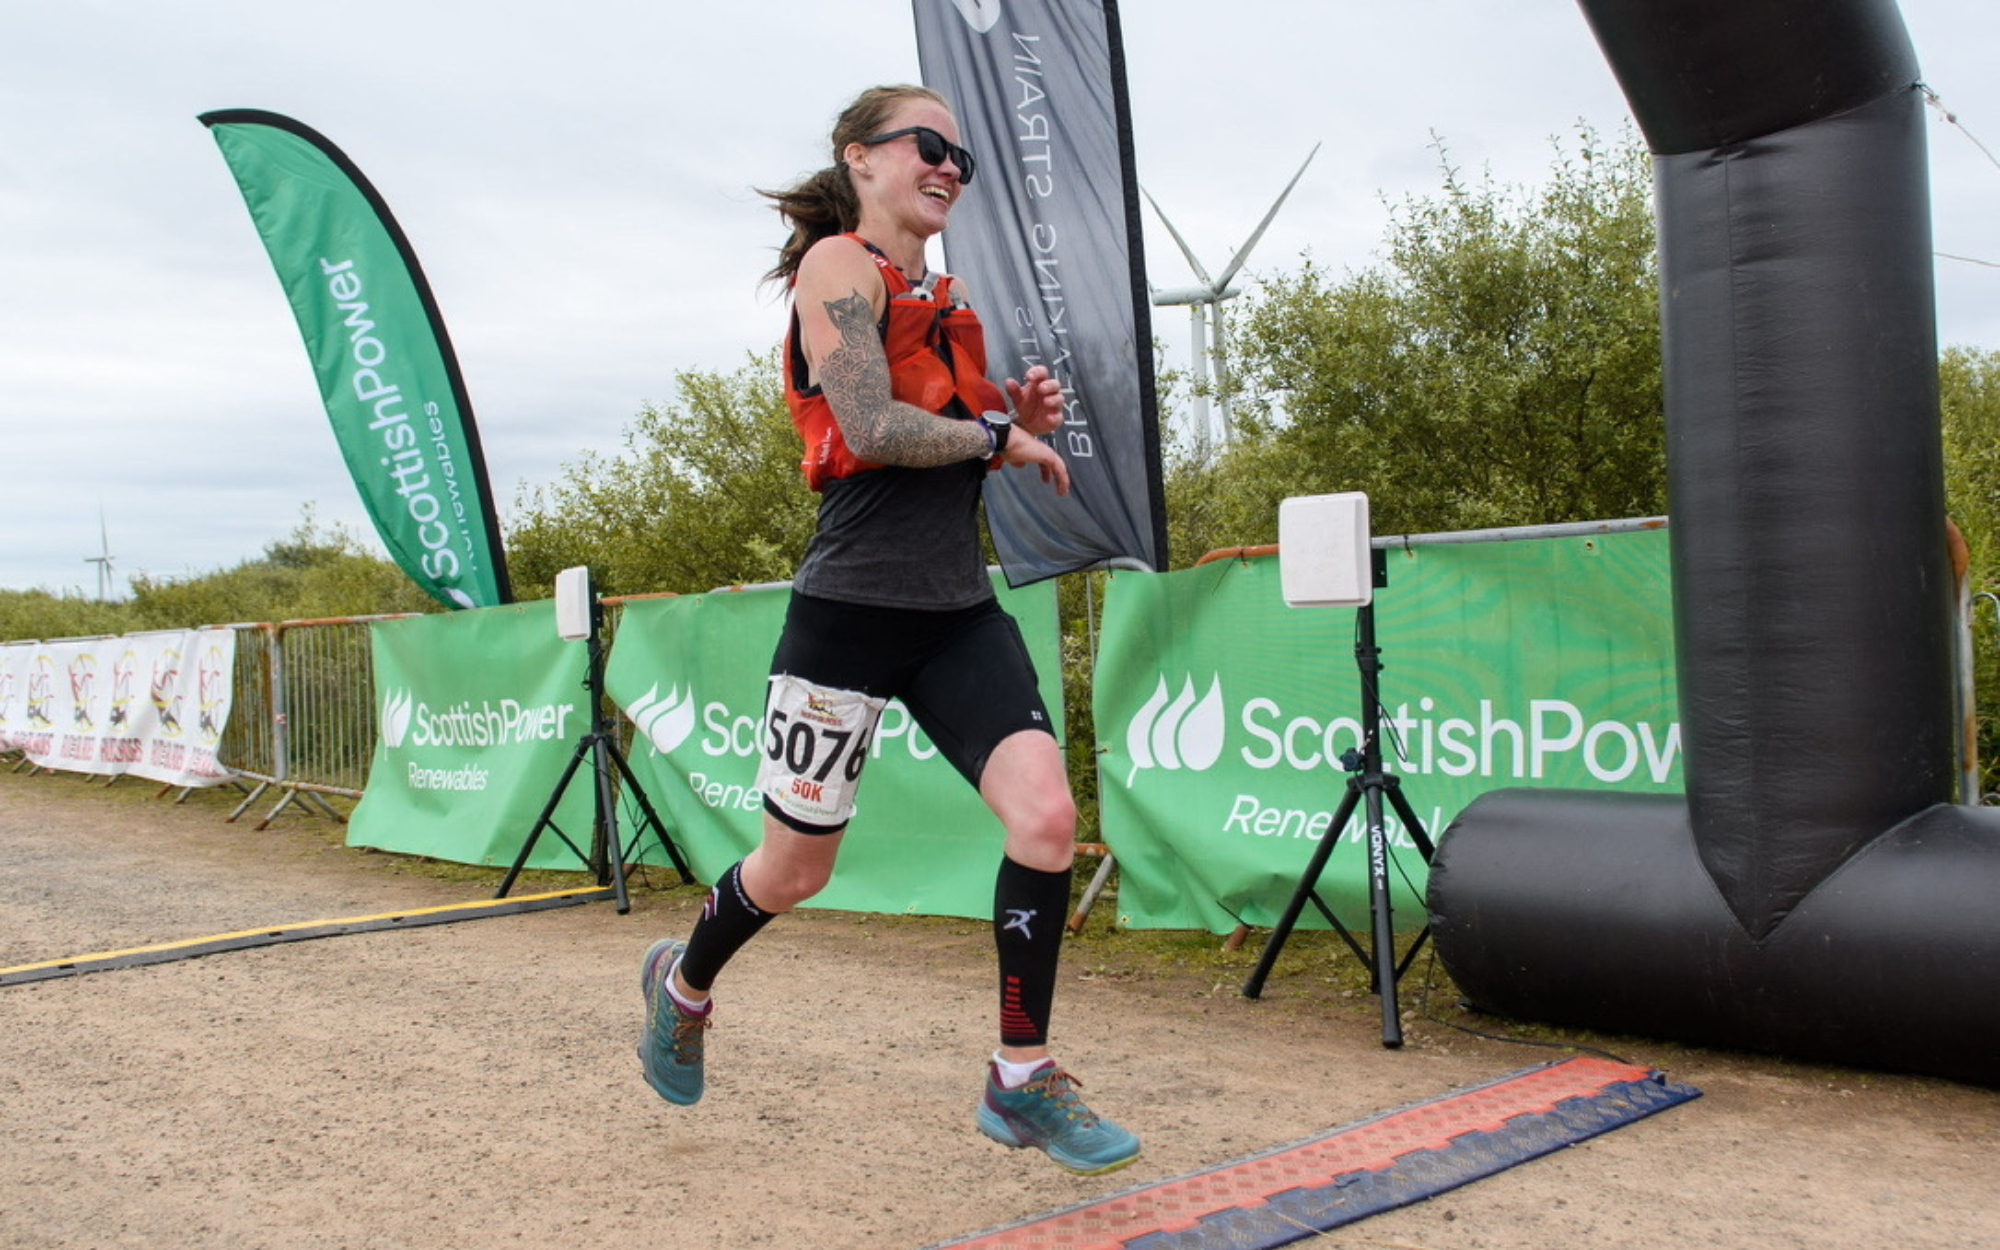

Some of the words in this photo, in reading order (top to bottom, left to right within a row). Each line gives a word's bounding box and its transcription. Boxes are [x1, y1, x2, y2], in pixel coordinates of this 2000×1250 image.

[319, 257, 459, 580] ScottishPower
[412, 699, 573, 747] ScottishPower
[767, 708, 868, 782] 5076
[1241, 697, 1682, 783] ScotishPow
[408, 761, 489, 791] Renewables
[791, 777, 824, 802] 50K
[1371, 824, 1385, 877] VONYX
